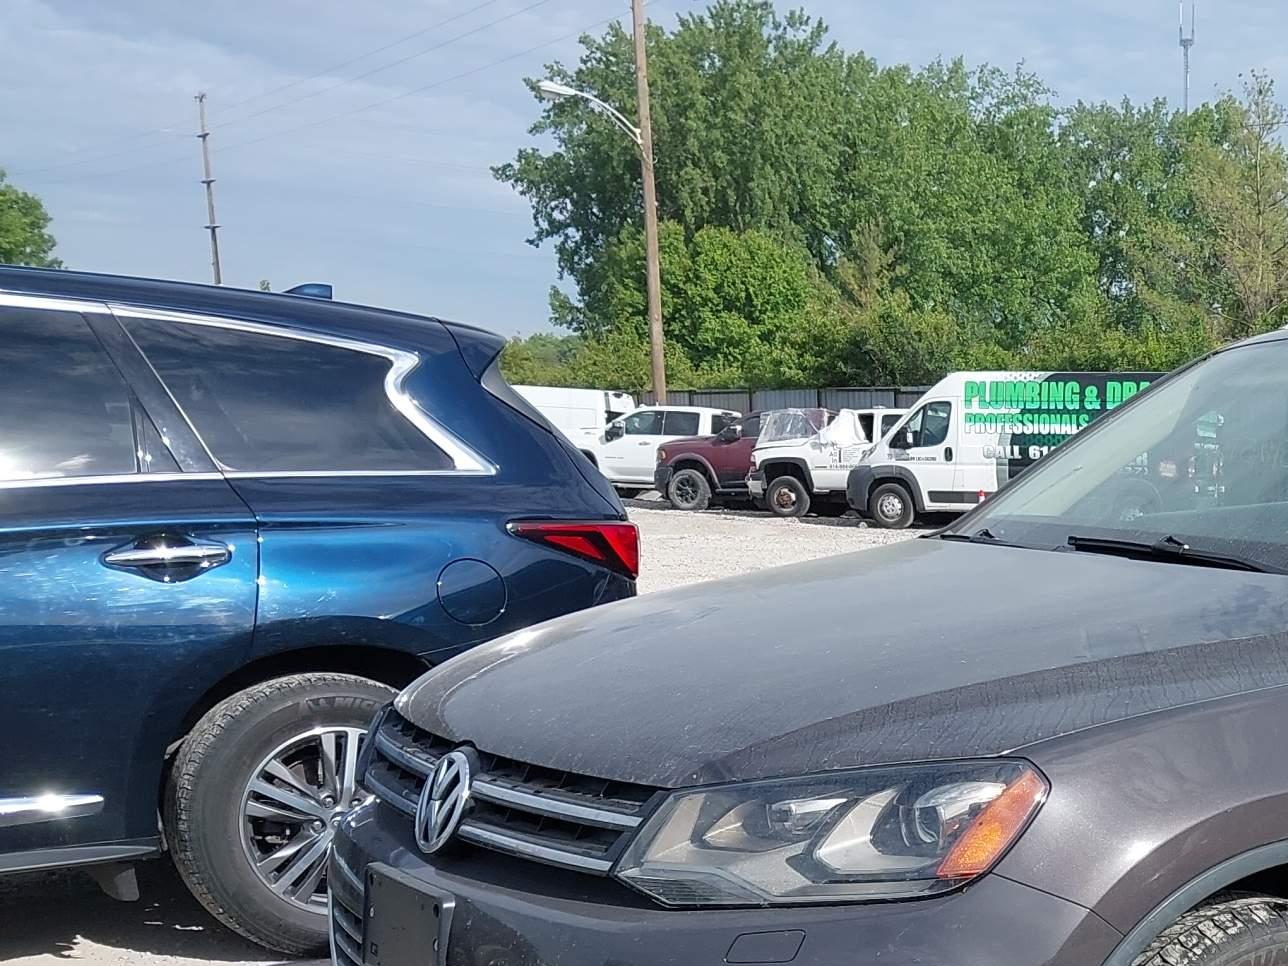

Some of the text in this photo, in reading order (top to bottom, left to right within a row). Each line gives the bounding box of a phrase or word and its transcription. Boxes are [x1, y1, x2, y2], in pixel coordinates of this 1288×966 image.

[964, 380, 1081, 410] PLUMBING
[1083, 385, 1101, 410] &
[964, 412, 1089, 435] PROFESSIONALS
[983, 444, 1056, 460] CALL 61
